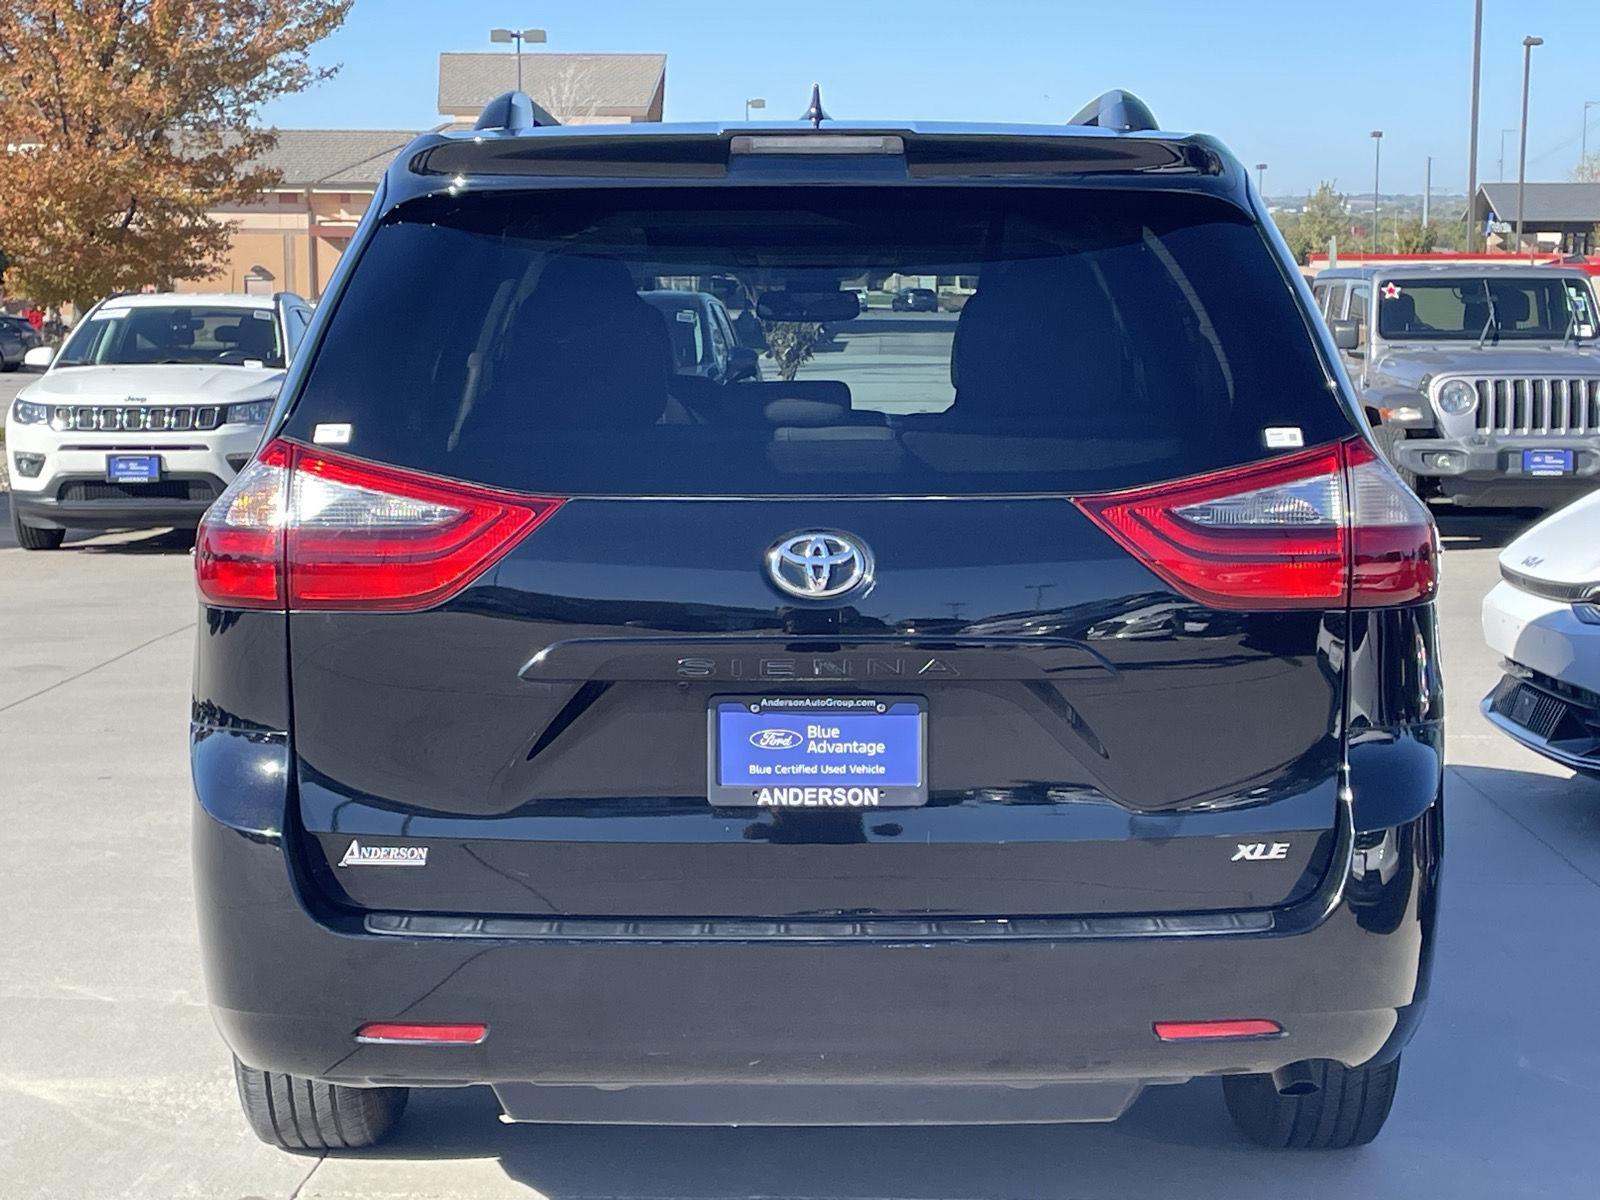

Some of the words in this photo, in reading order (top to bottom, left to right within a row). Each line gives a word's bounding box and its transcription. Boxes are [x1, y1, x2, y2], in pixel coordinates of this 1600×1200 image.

[676, 658, 961, 678] SIENNA
[760, 698, 876, 708] AndersonAutoGroup.com
[759, 729, 793, 747] Ford
[807, 725, 840, 739] Blue
[806, 740, 886, 756] Advantage
[749, 765, 772, 774] Blue
[774, 764, 817, 774] Certified
[820, 764, 846, 774] Used
[849, 764, 886, 774] Vehicle
[756, 788, 879, 806] ANDERSON
[1230, 842, 1291, 862] XLE
